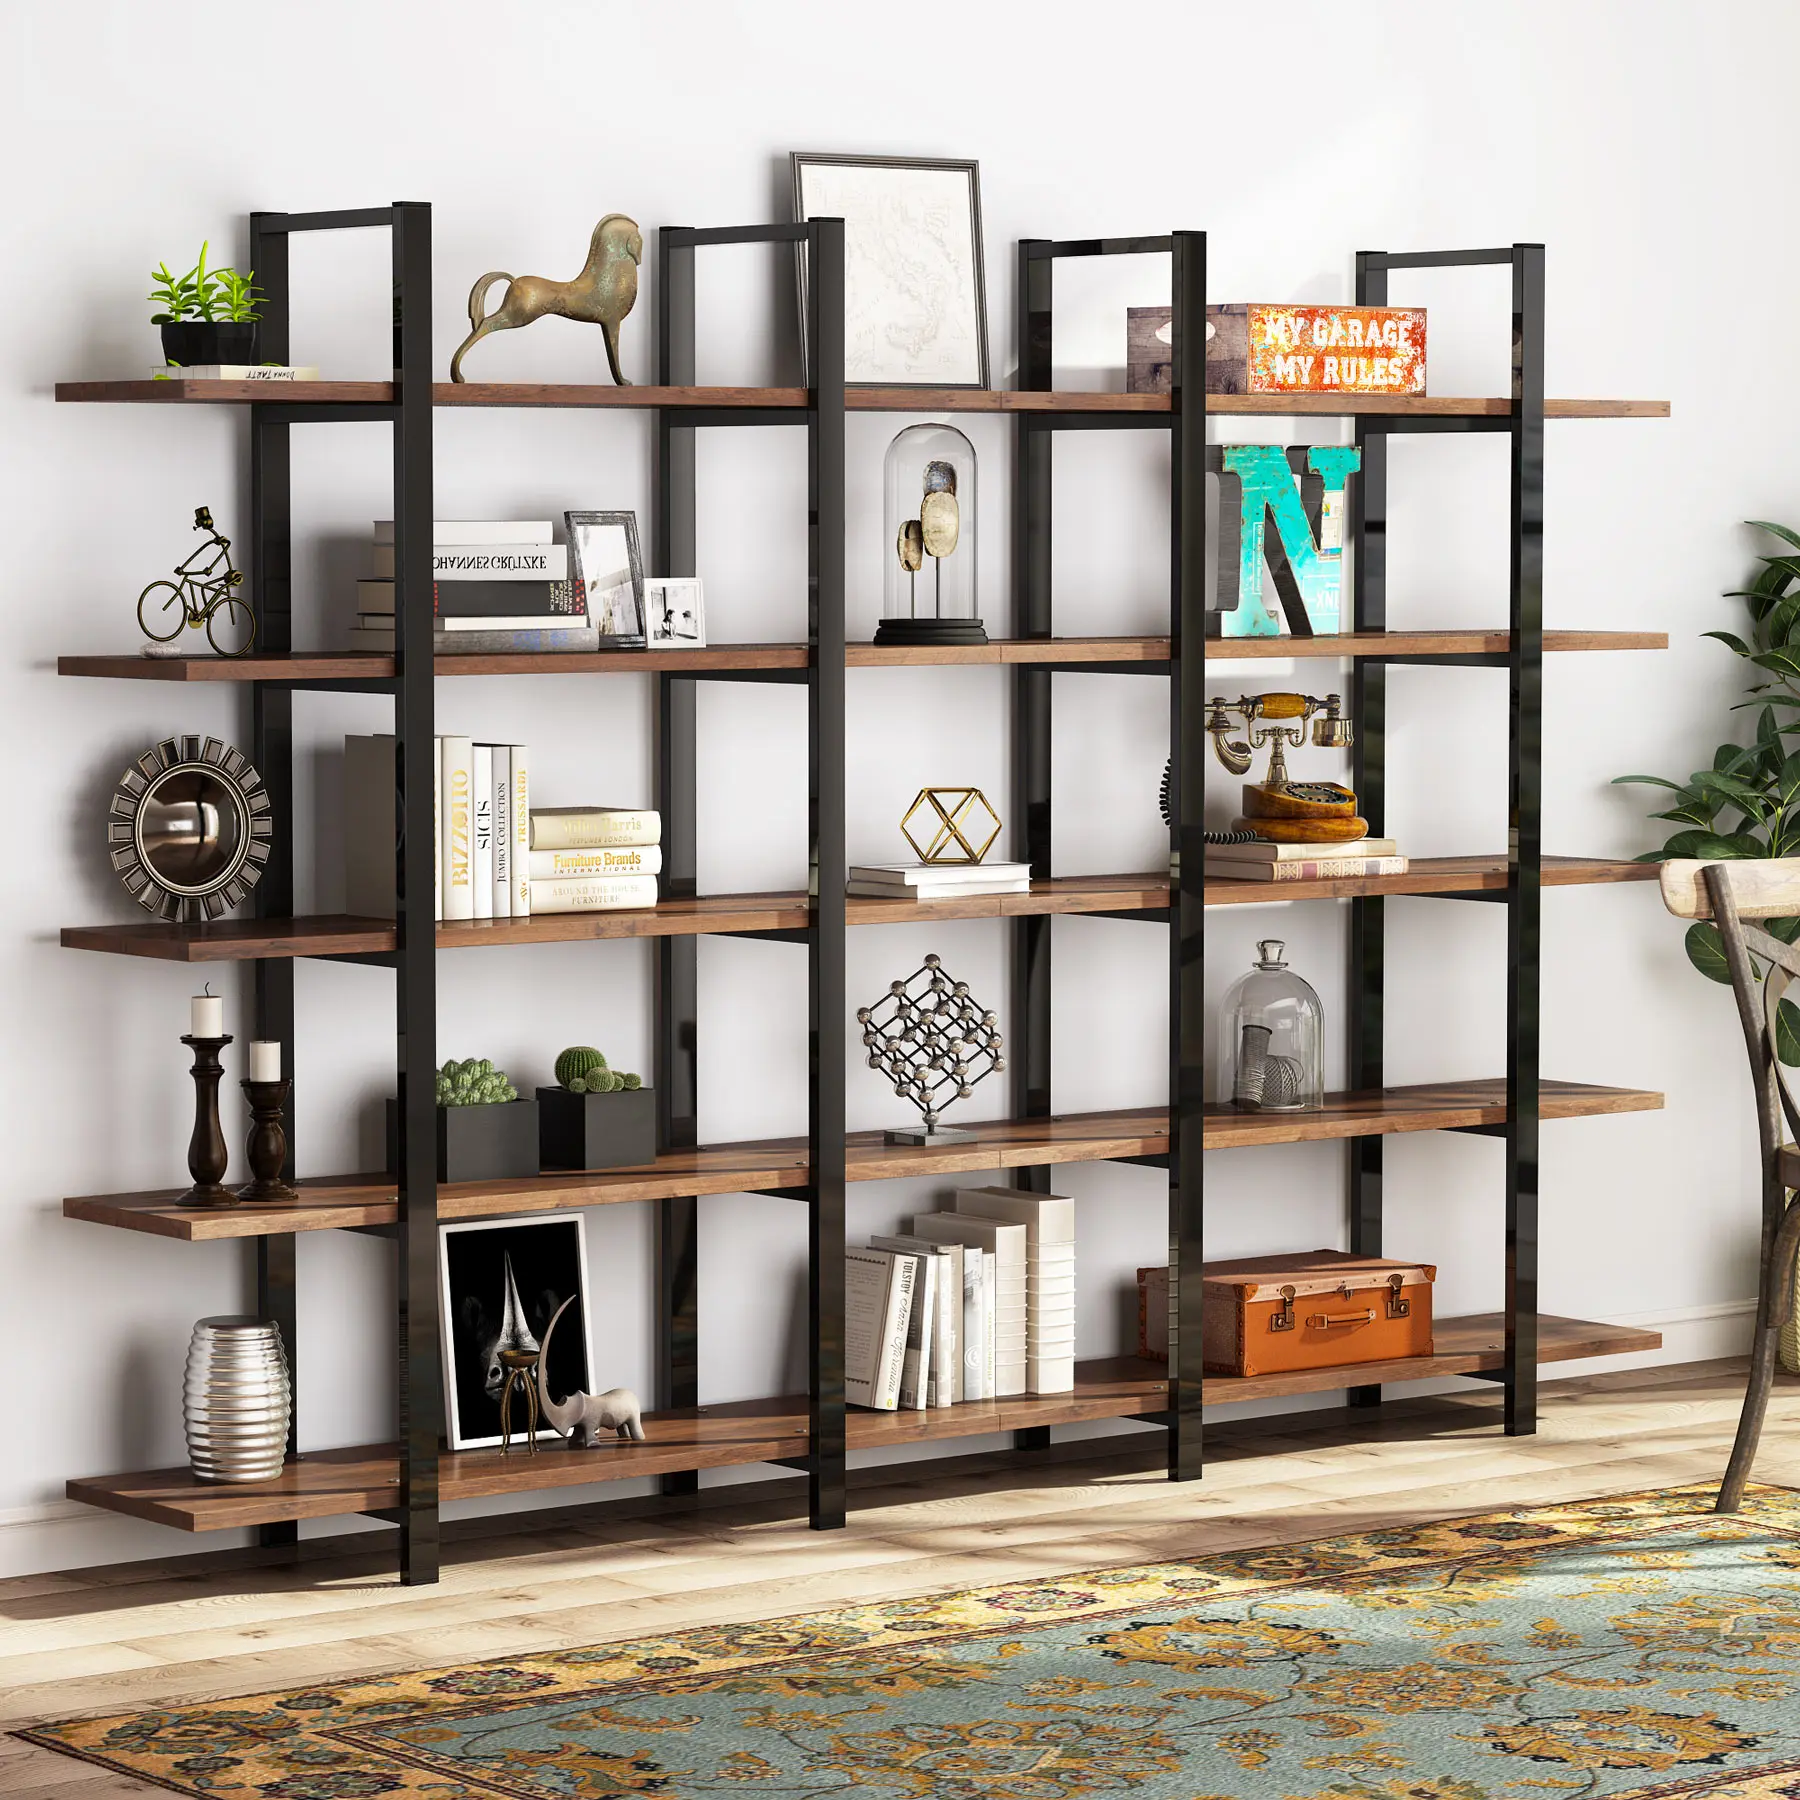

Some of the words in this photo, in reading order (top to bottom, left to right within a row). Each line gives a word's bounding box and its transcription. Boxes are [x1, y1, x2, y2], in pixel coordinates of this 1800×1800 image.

[1265, 315, 1305, 346] MY
[1312, 317, 1412, 348] GARAGE
[246, 370, 271, 380] TARTT
[274, 371, 296, 381] DONNA
[1274, 355, 1315, 384] MY
[1323, 356, 1405, 385] RULES
[496, 782, 506, 846] COLLECTION
[517, 769, 526, 843] TRUSSARDI
[476, 800, 490, 850] SICIS
[601, 817, 642, 833] Harris
[496, 848, 507, 883] JUMBO
[553, 853, 602, 868] Furniture
[603, 851, 641, 867] Brands
[554, 865, 641, 875] INTERNATIONAL
[552, 886, 588, 897] AROUND
[591, 885, 608, 894] THE
[572, 895, 620, 905] FURNITURE
[899, 1260, 914, 1295] TOLSTOY
[896, 1298, 909, 1333] Anna
[887, 1335, 903, 1394] Karenina
